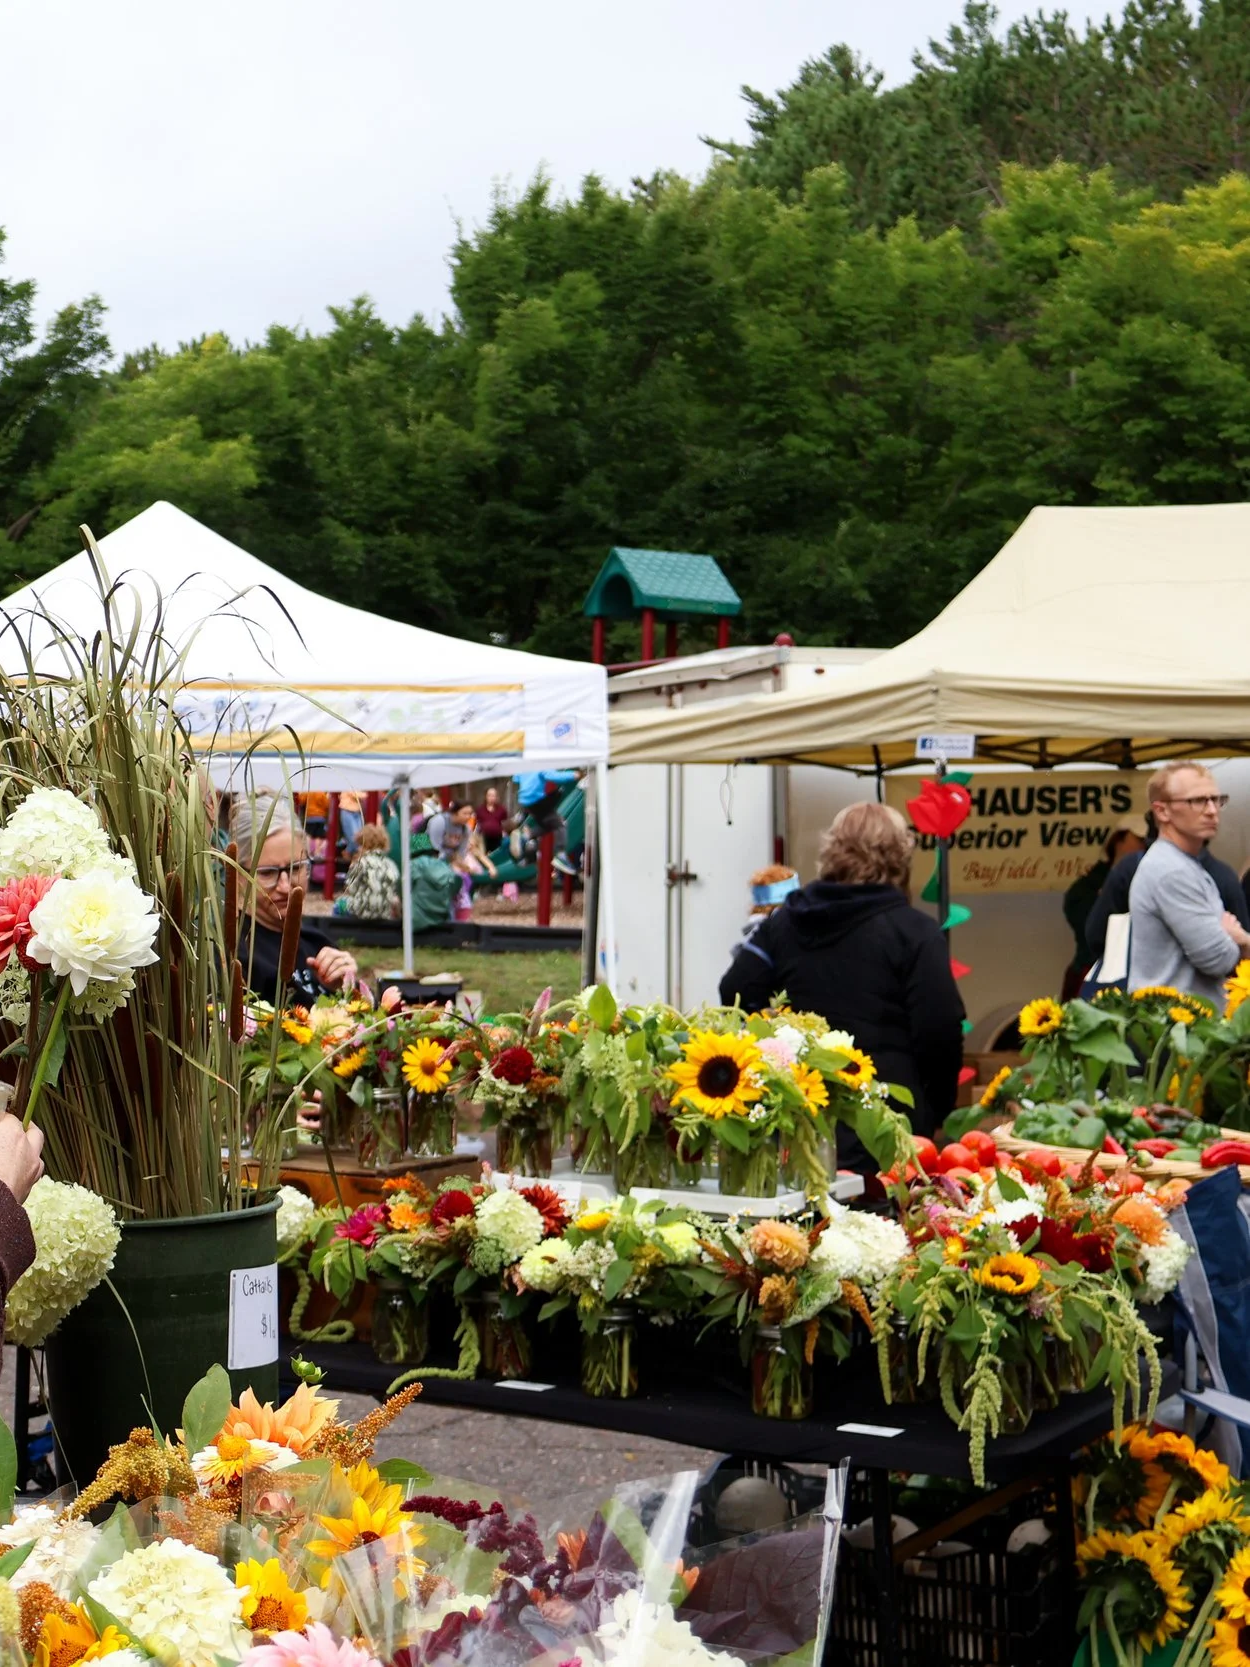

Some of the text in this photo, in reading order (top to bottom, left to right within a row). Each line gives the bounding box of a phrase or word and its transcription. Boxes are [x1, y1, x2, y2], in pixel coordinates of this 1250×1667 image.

[966, 785, 1131, 816] HAUSER'S
[1039, 822, 1111, 847] View
[242, 1273, 273, 1297] Cattails
